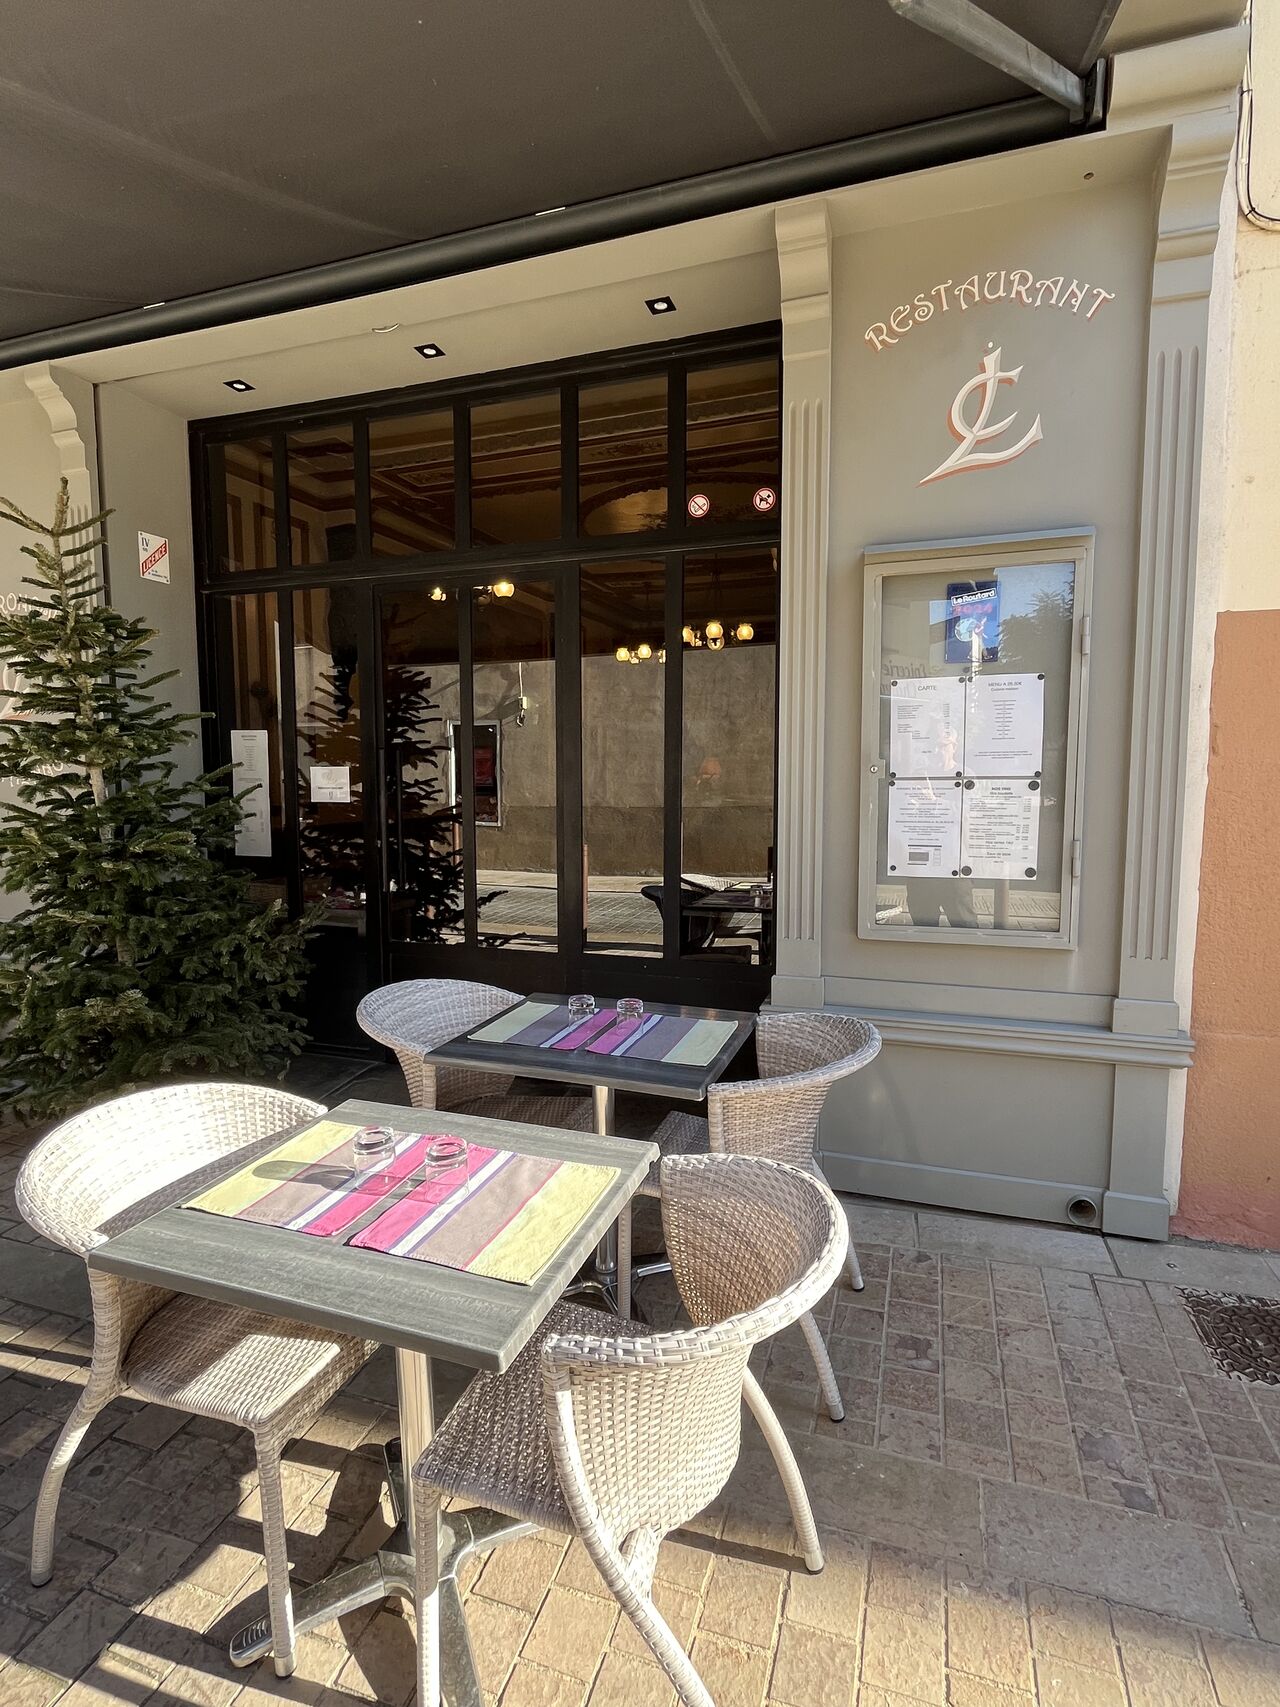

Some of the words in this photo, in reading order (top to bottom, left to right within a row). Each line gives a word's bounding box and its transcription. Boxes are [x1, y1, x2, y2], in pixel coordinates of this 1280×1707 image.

[864, 268, 1116, 352] RESTAURANT
[141, 537, 150, 547] IV
[143, 543, 167, 573] LICENCE
[953, 597, 963, 605] Le
[963, 590, 995, 603] Routard
